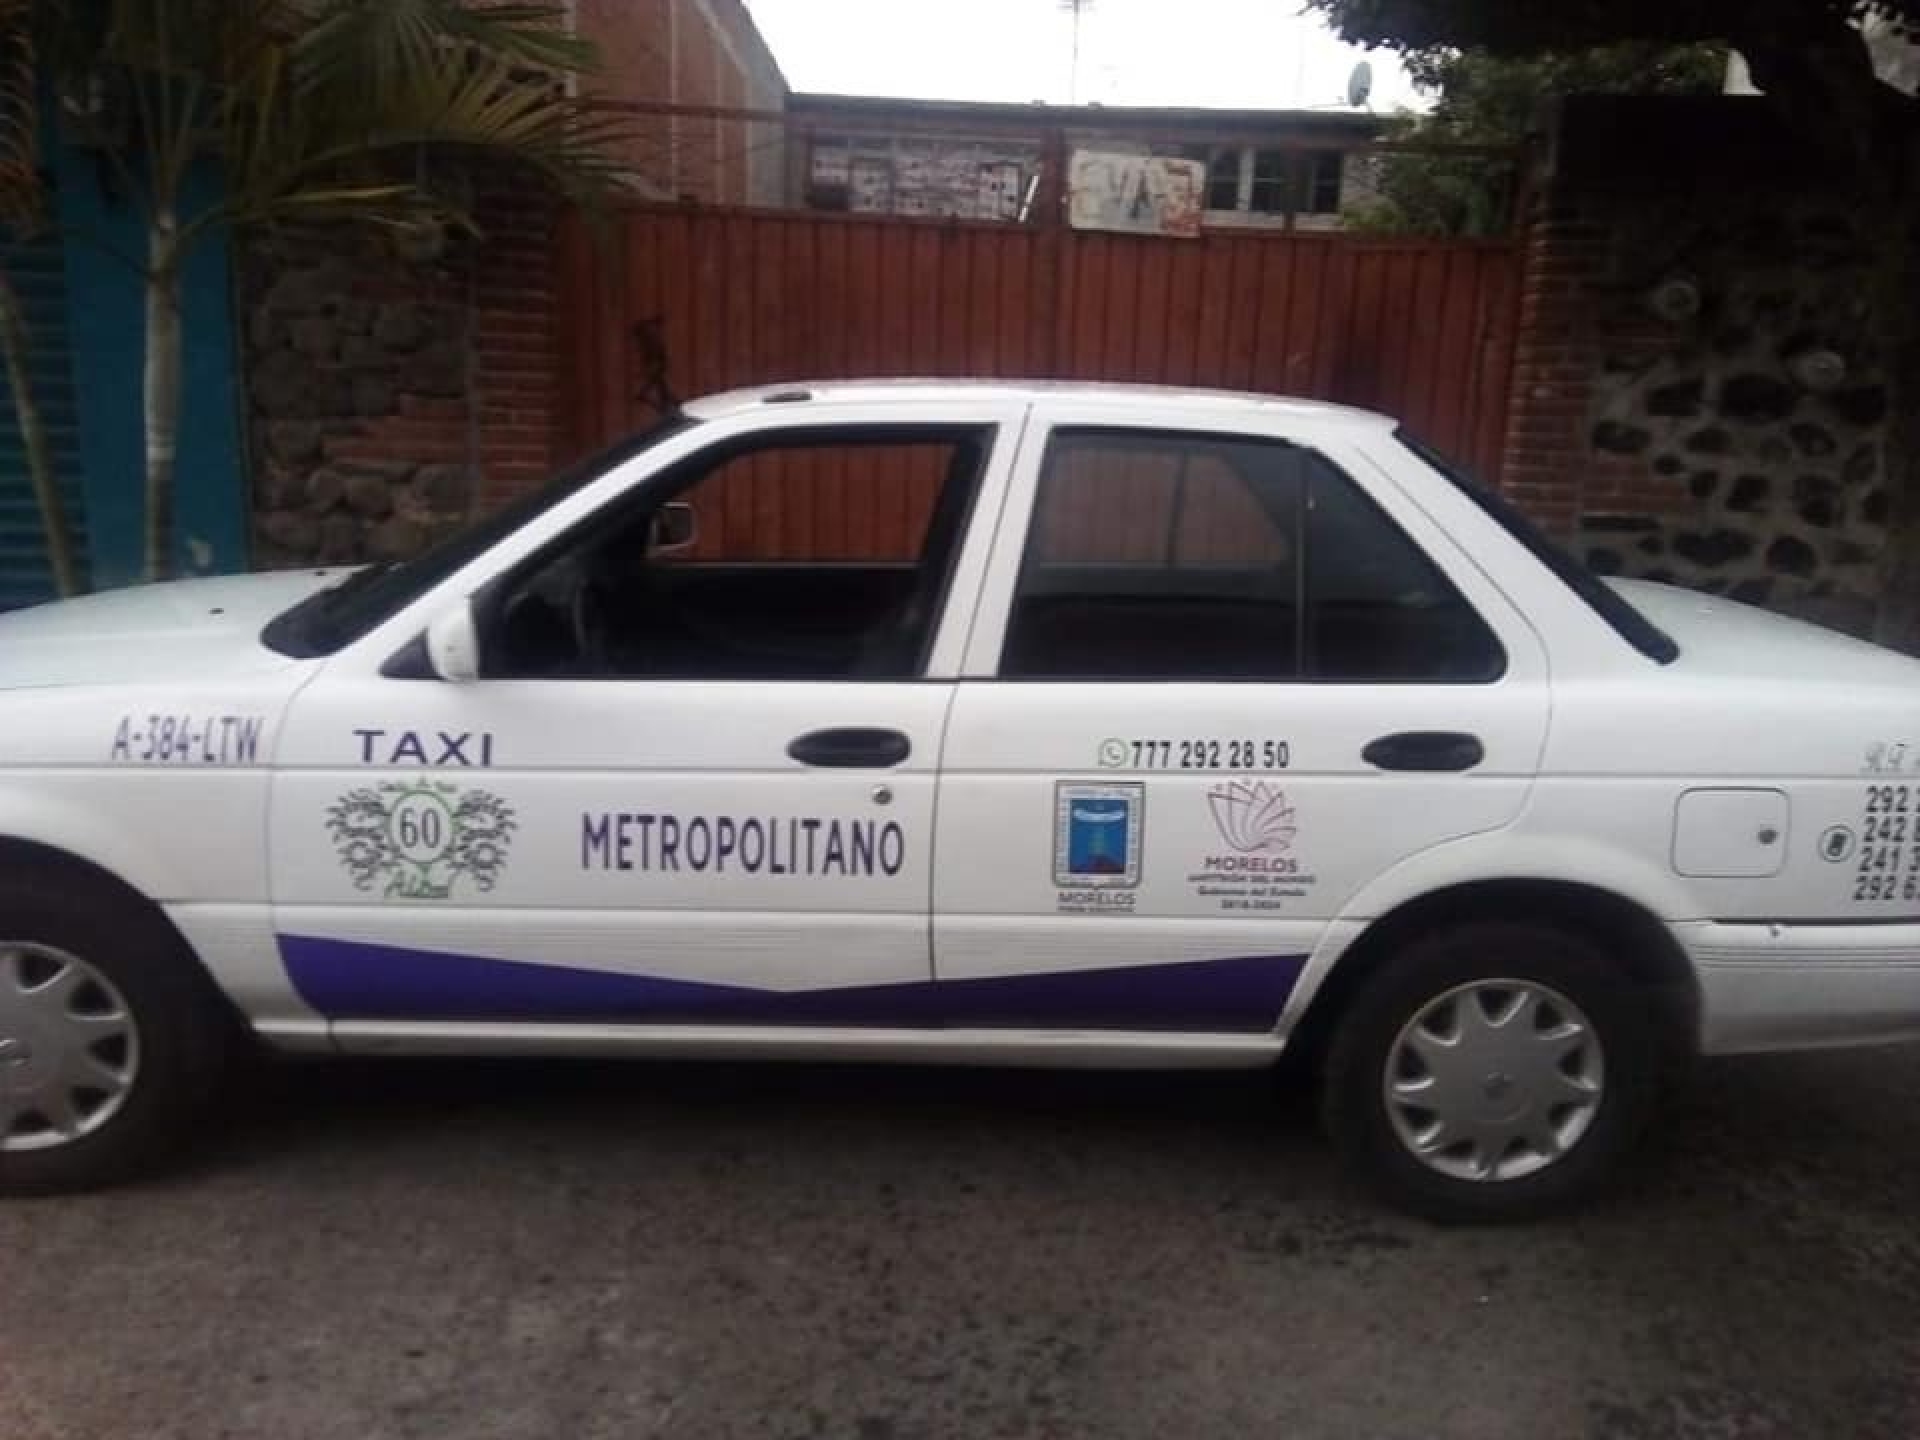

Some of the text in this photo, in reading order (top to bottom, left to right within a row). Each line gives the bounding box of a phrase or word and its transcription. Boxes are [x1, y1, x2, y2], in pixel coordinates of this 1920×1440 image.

[111, 714, 266, 763] A-384-LTW
[354, 729, 493, 767] TAXI
[1131, 740, 1290, 768] 777 292 28 50
[1866, 785, 1908, 812] 292
[400, 808, 440, 848] 60
[1864, 815, 1907, 843] 242
[582, 812, 904, 876] METROPOLITANO
[1205, 856, 1297, 873] MORELOS
[1859, 846, 1899, 873] 241
